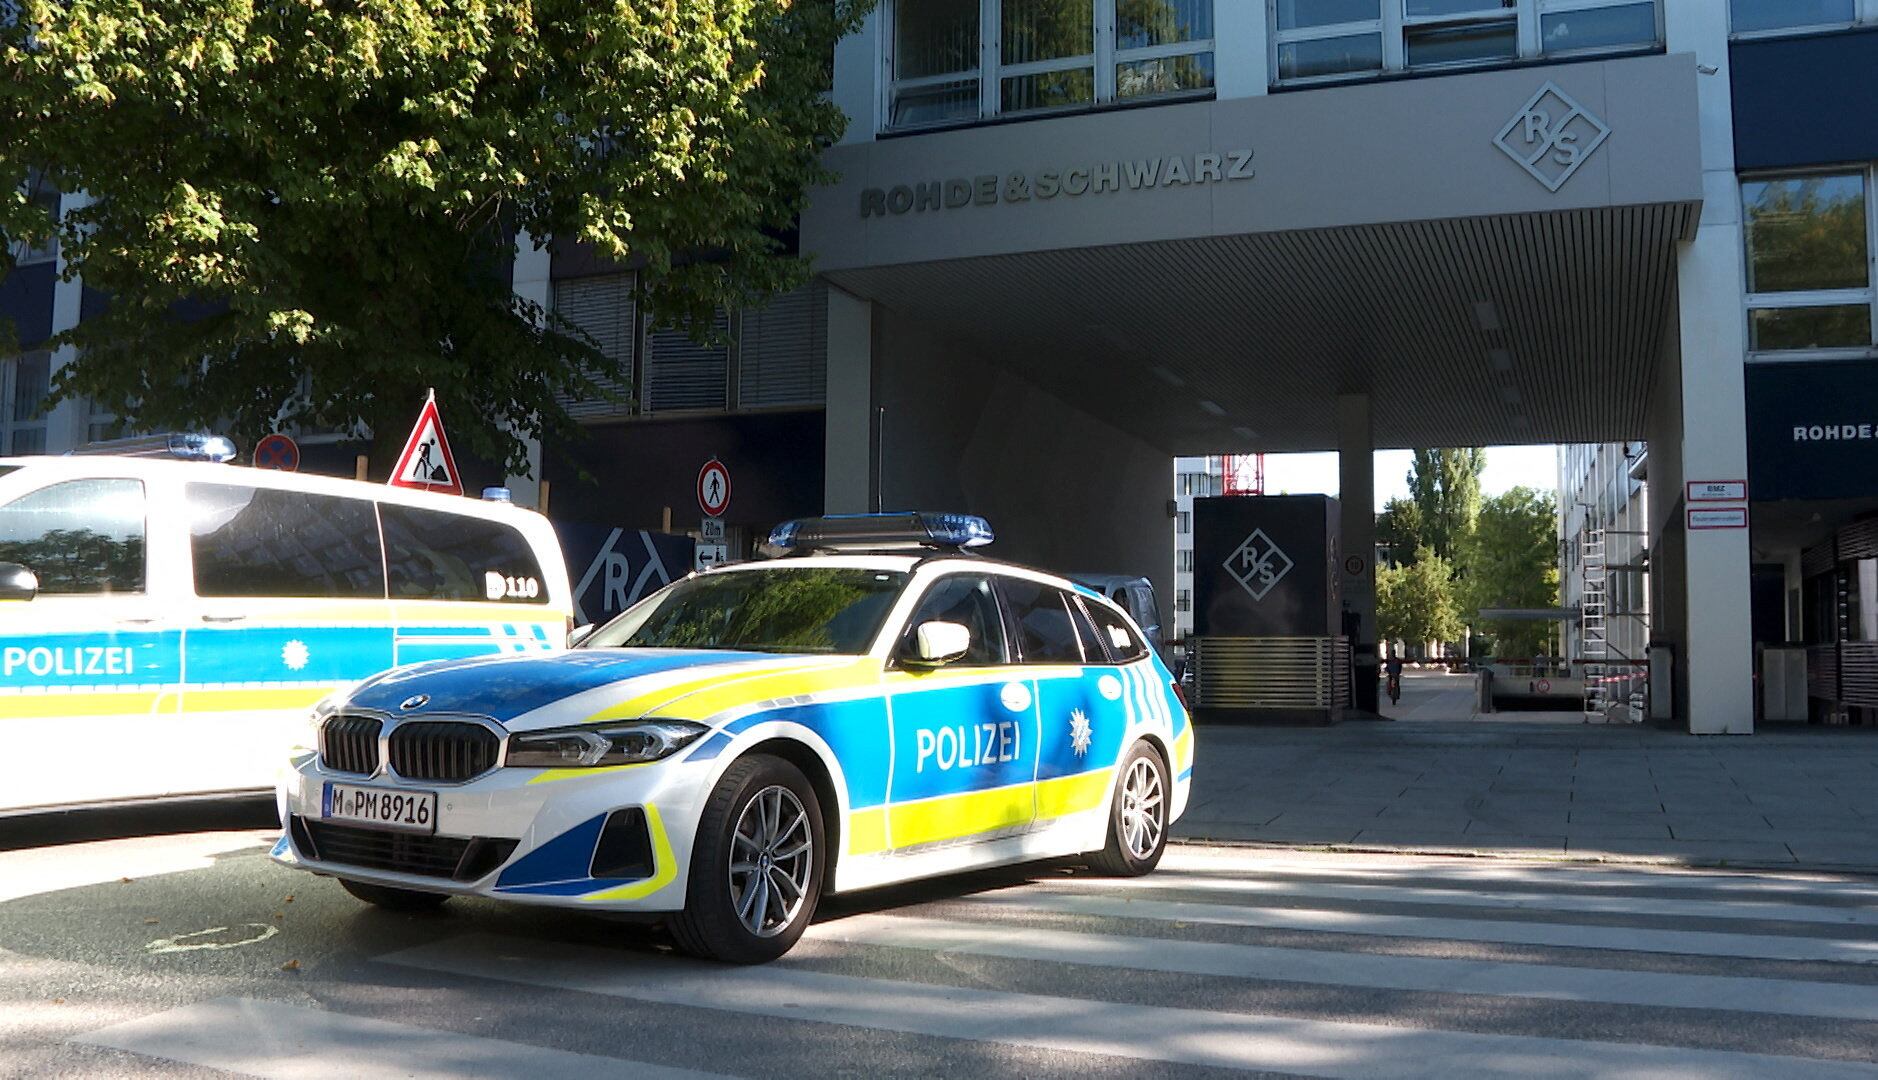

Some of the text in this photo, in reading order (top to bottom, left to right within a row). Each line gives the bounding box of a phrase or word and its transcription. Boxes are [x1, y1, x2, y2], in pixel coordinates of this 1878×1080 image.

[860, 149, 1255, 218] ROHDE&SCHWARZ
[1793, 424, 1878, 441] ROHDE
[506, 576, 539, 598] 110
[4, 646, 133, 676] POLIZEI
[916, 721, 1020, 773] POLIZEI
[381, 793, 429, 824] 8916
